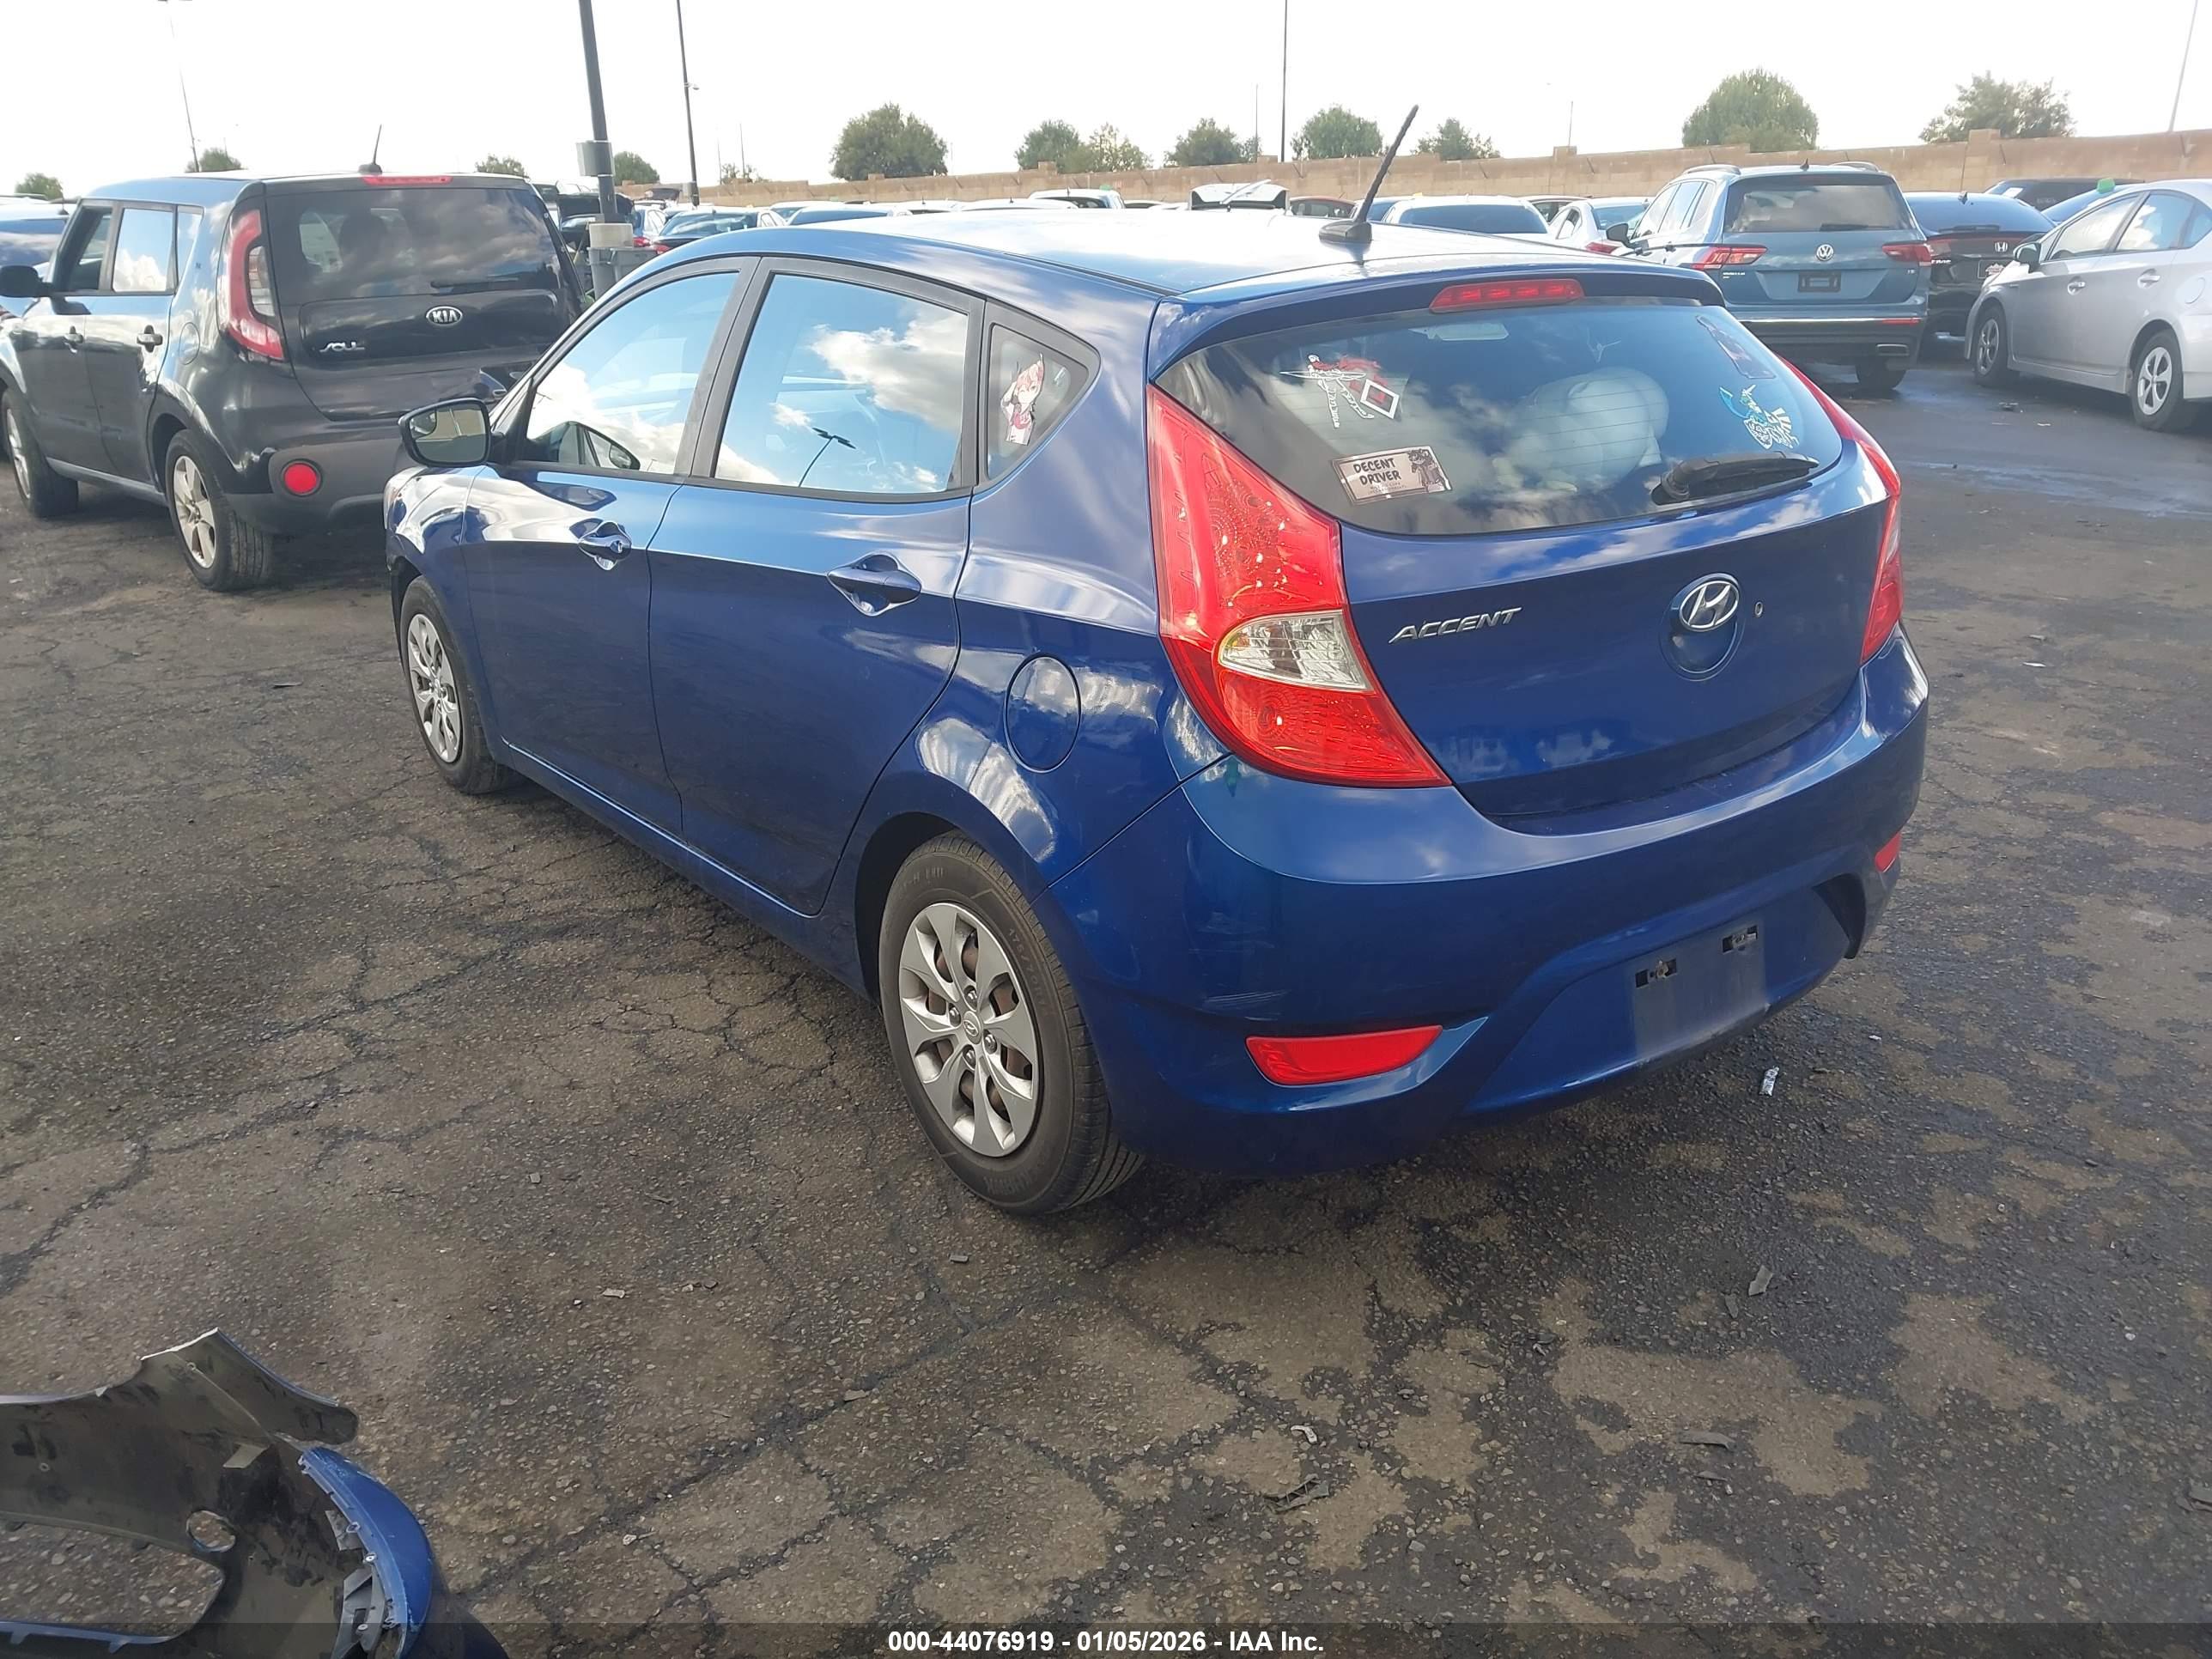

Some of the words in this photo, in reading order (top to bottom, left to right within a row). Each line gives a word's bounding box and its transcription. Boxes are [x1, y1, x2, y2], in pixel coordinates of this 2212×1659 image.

[432, 310, 458, 322] KIA
[1353, 458, 1396, 473] DECENT
[1359, 470, 1401, 485] DRIVER
[1388, 607, 1522, 644] ACCENT
